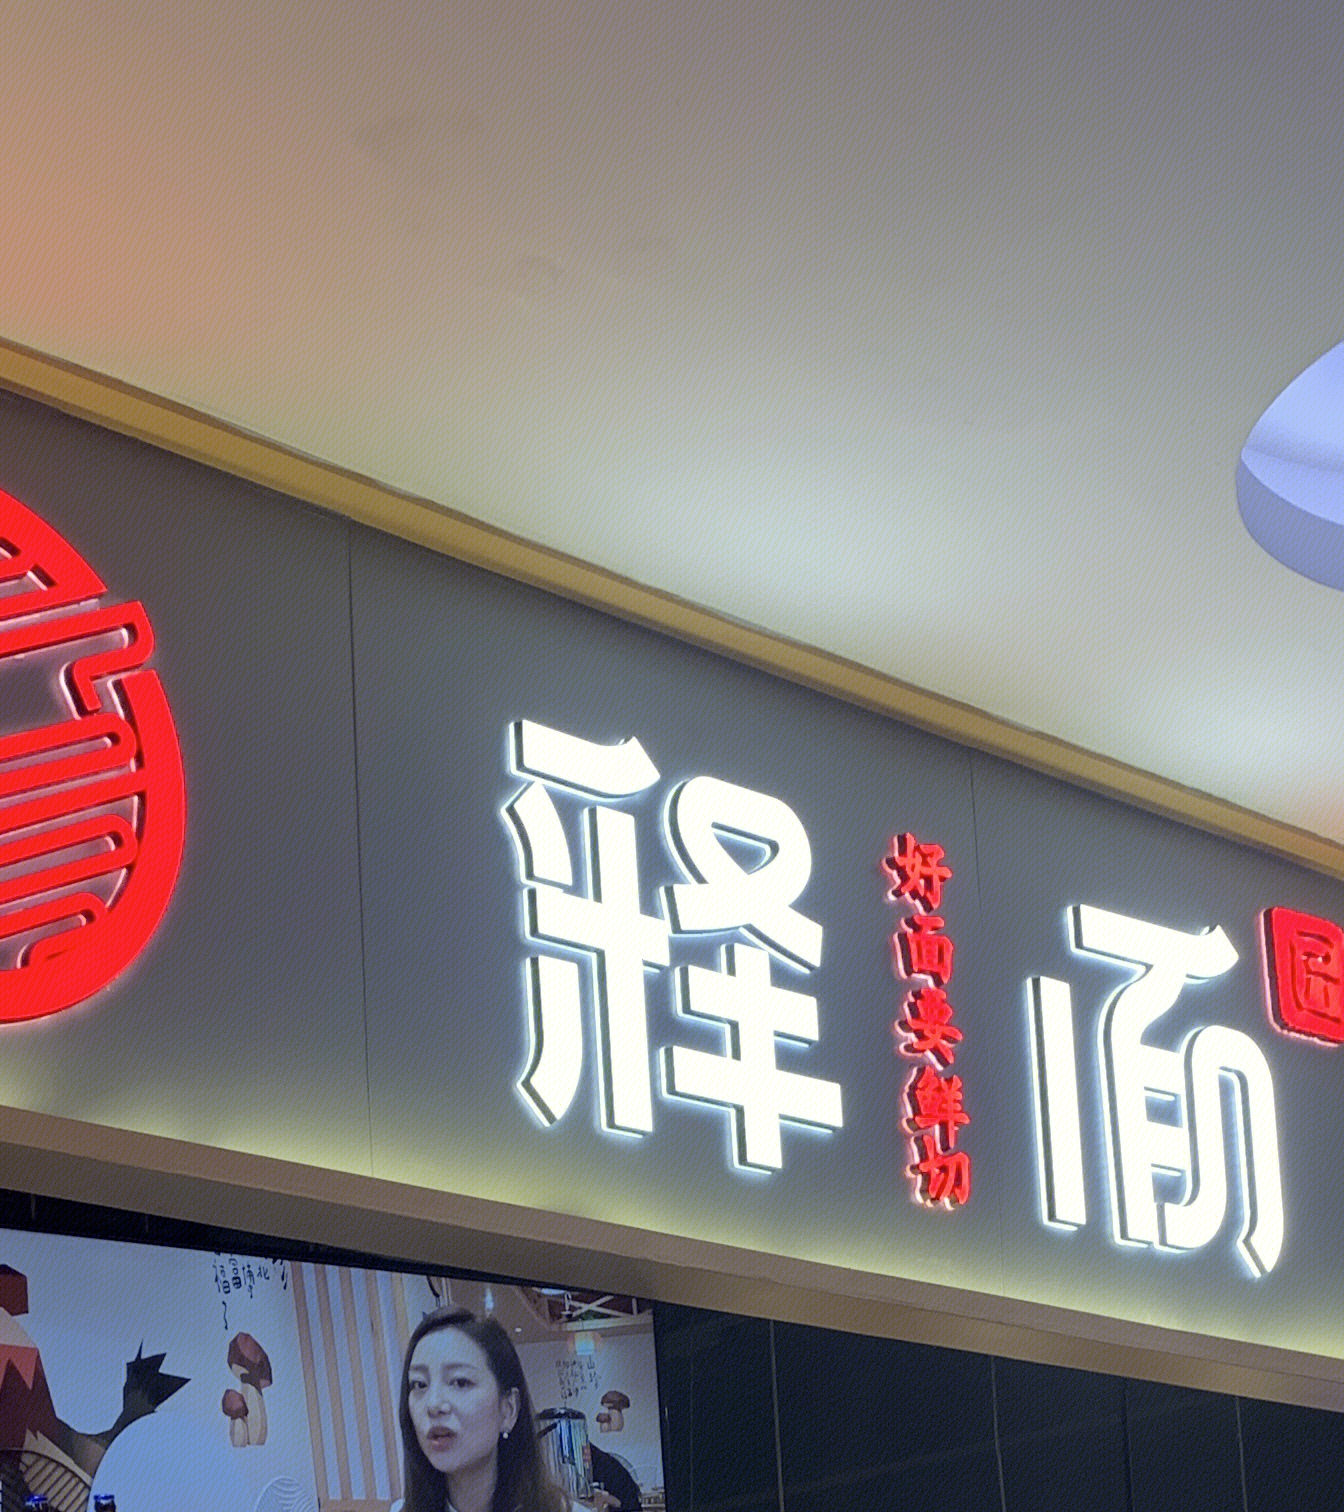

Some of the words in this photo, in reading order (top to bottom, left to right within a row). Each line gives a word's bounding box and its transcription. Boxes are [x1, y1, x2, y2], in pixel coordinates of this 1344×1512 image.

[883, 832, 970, 1210] 好面要鲜切
